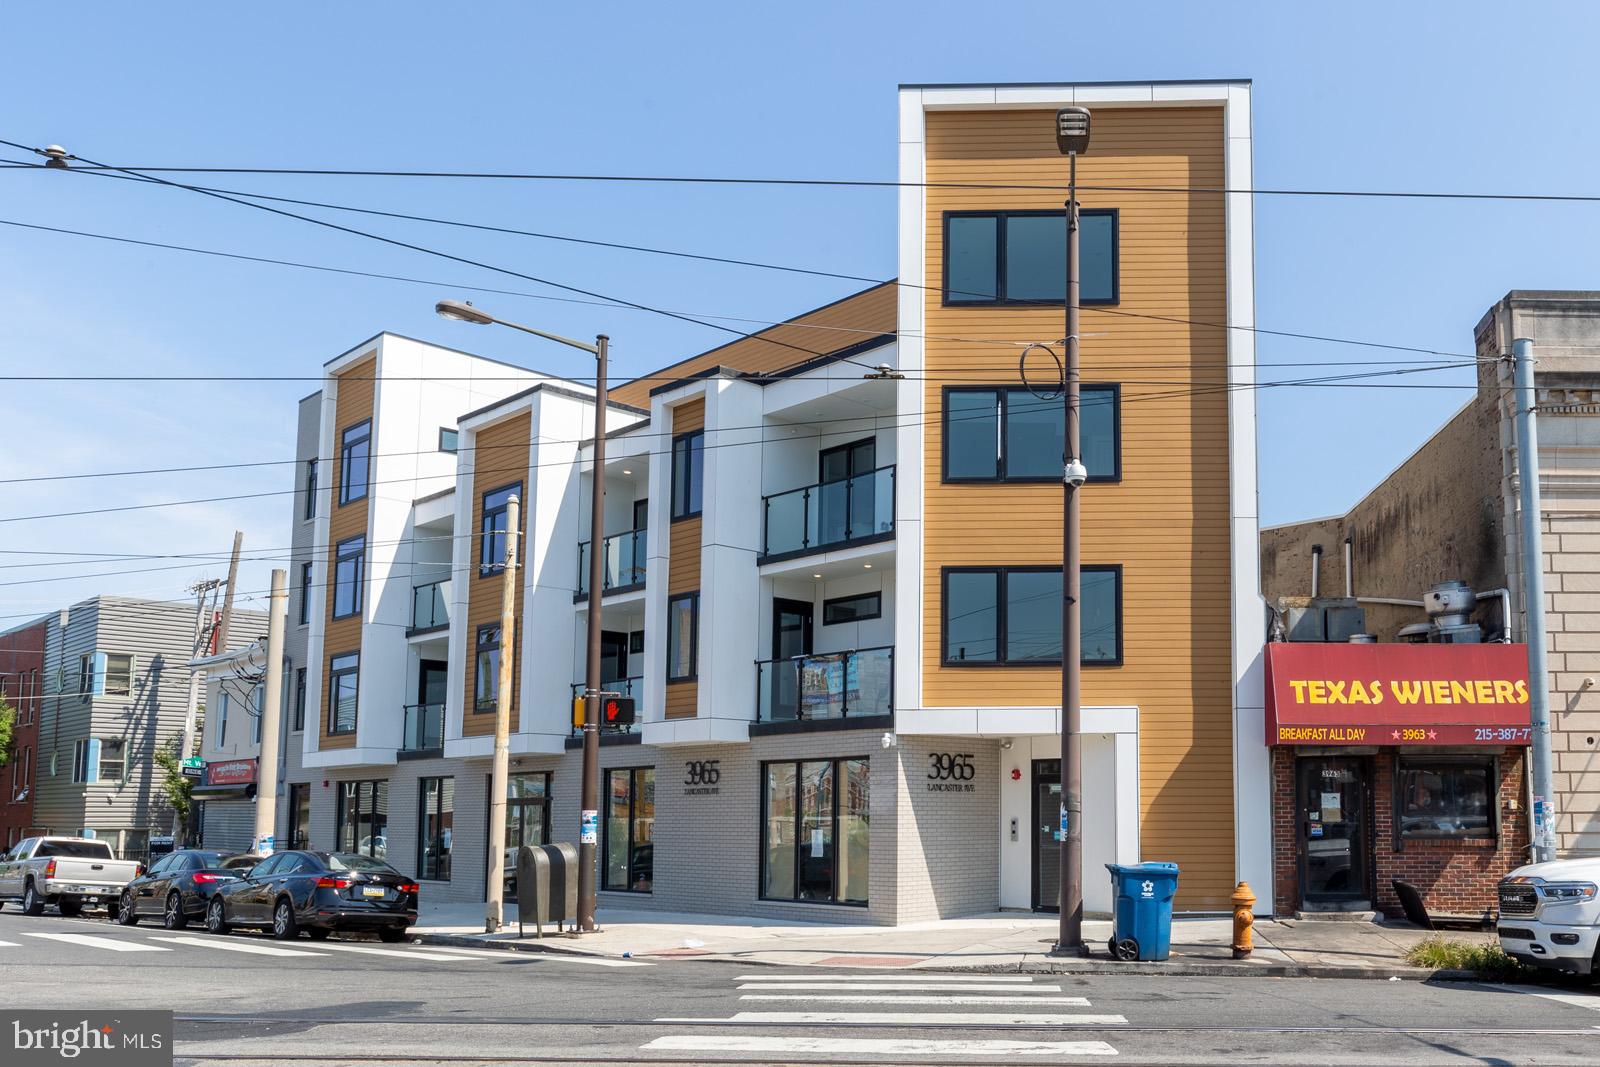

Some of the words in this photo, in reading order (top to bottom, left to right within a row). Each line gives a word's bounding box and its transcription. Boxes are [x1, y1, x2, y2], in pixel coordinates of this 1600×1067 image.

[1289, 679, 1384, 705] TEXAS
[1391, 679, 1530, 705] WIENERS
[1279, 727, 1328, 741] BREAKFAST
[1329, 727, 1346, 741] ALL
[1346, 727, 1366, 741] DAY
[1402, 728, 1425, 741] 3963
[684, 760, 720, 785] 3965
[927, 752, 975, 781] 3965
[927, 783, 963, 793] LANCASTER
